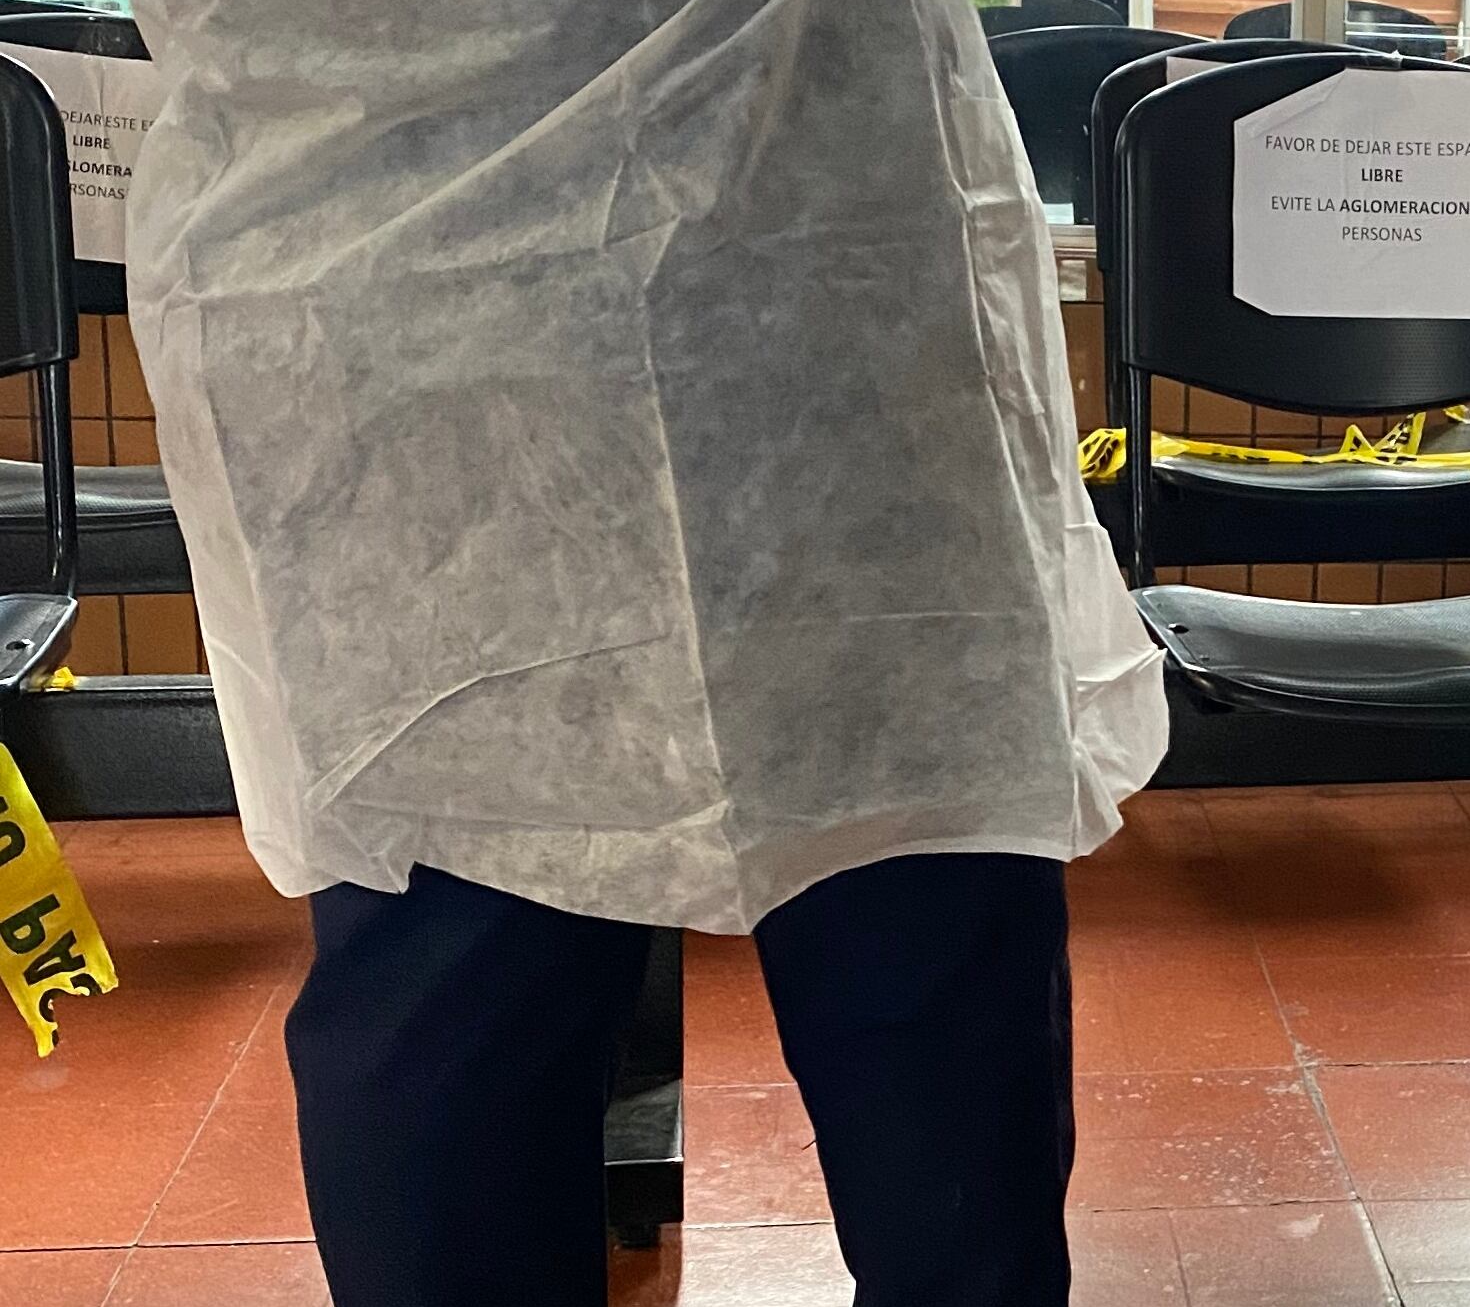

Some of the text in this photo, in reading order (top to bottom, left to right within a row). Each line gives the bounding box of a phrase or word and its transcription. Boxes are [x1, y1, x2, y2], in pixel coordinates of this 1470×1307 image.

[104, 115, 137, 131] ESTE
[72, 135, 111, 150] LIBRE
[1265, 135, 1316, 153] FAVOR
[1320, 139, 1341, 154] DE
[1345, 139, 1392, 156] DEJAR
[1396, 141, 1432, 157] ESTE
[1360, 168, 1404, 183] LIBRE
[1271, 195, 1312, 211] EVITE
[1317, 198, 1336, 212] LA
[1339, 199, 1470, 216] AGLOMERACION
[1342, 226, 1423, 242] PERSONAS
